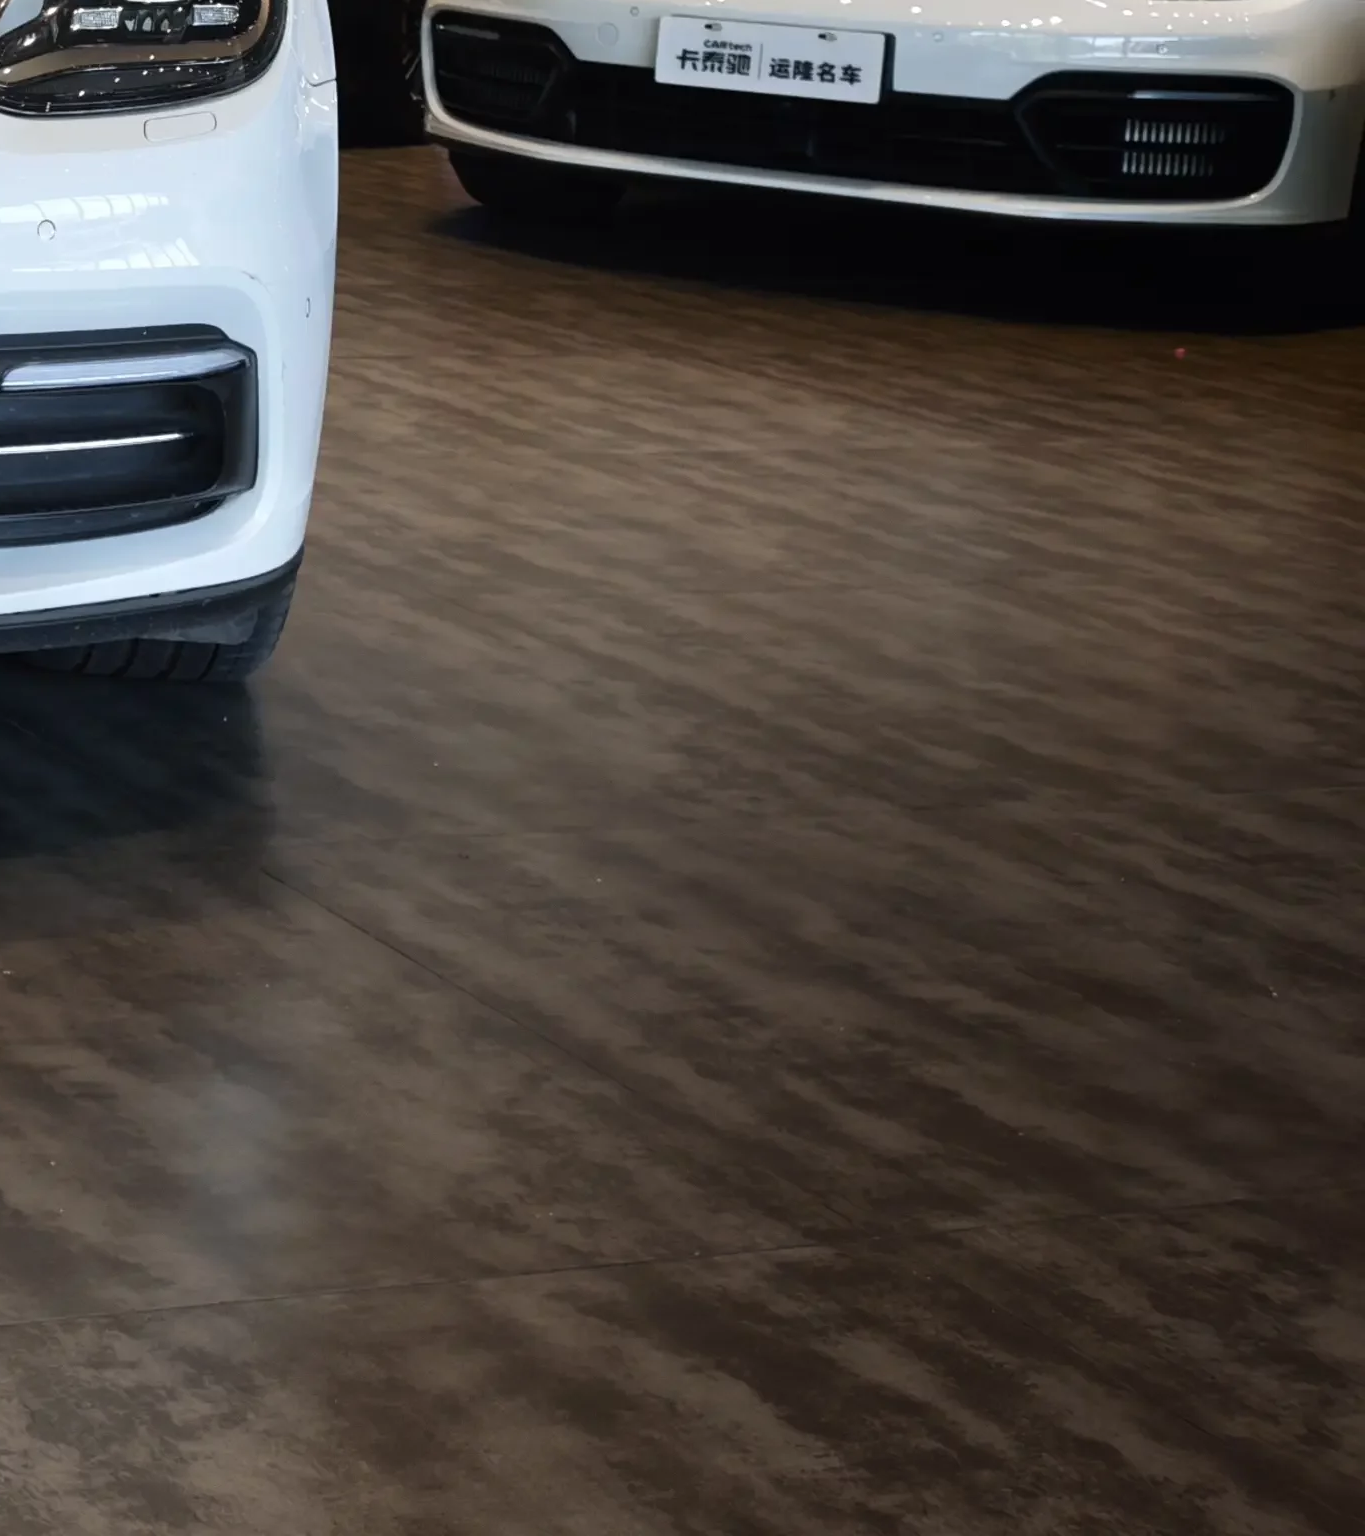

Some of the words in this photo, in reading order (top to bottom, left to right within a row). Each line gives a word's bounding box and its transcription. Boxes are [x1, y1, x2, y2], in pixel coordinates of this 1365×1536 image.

[703, 39, 752, 52] CARtech
[676, 49, 751, 76] 卡泰驰
[769, 58, 862, 85] 运隆名车
